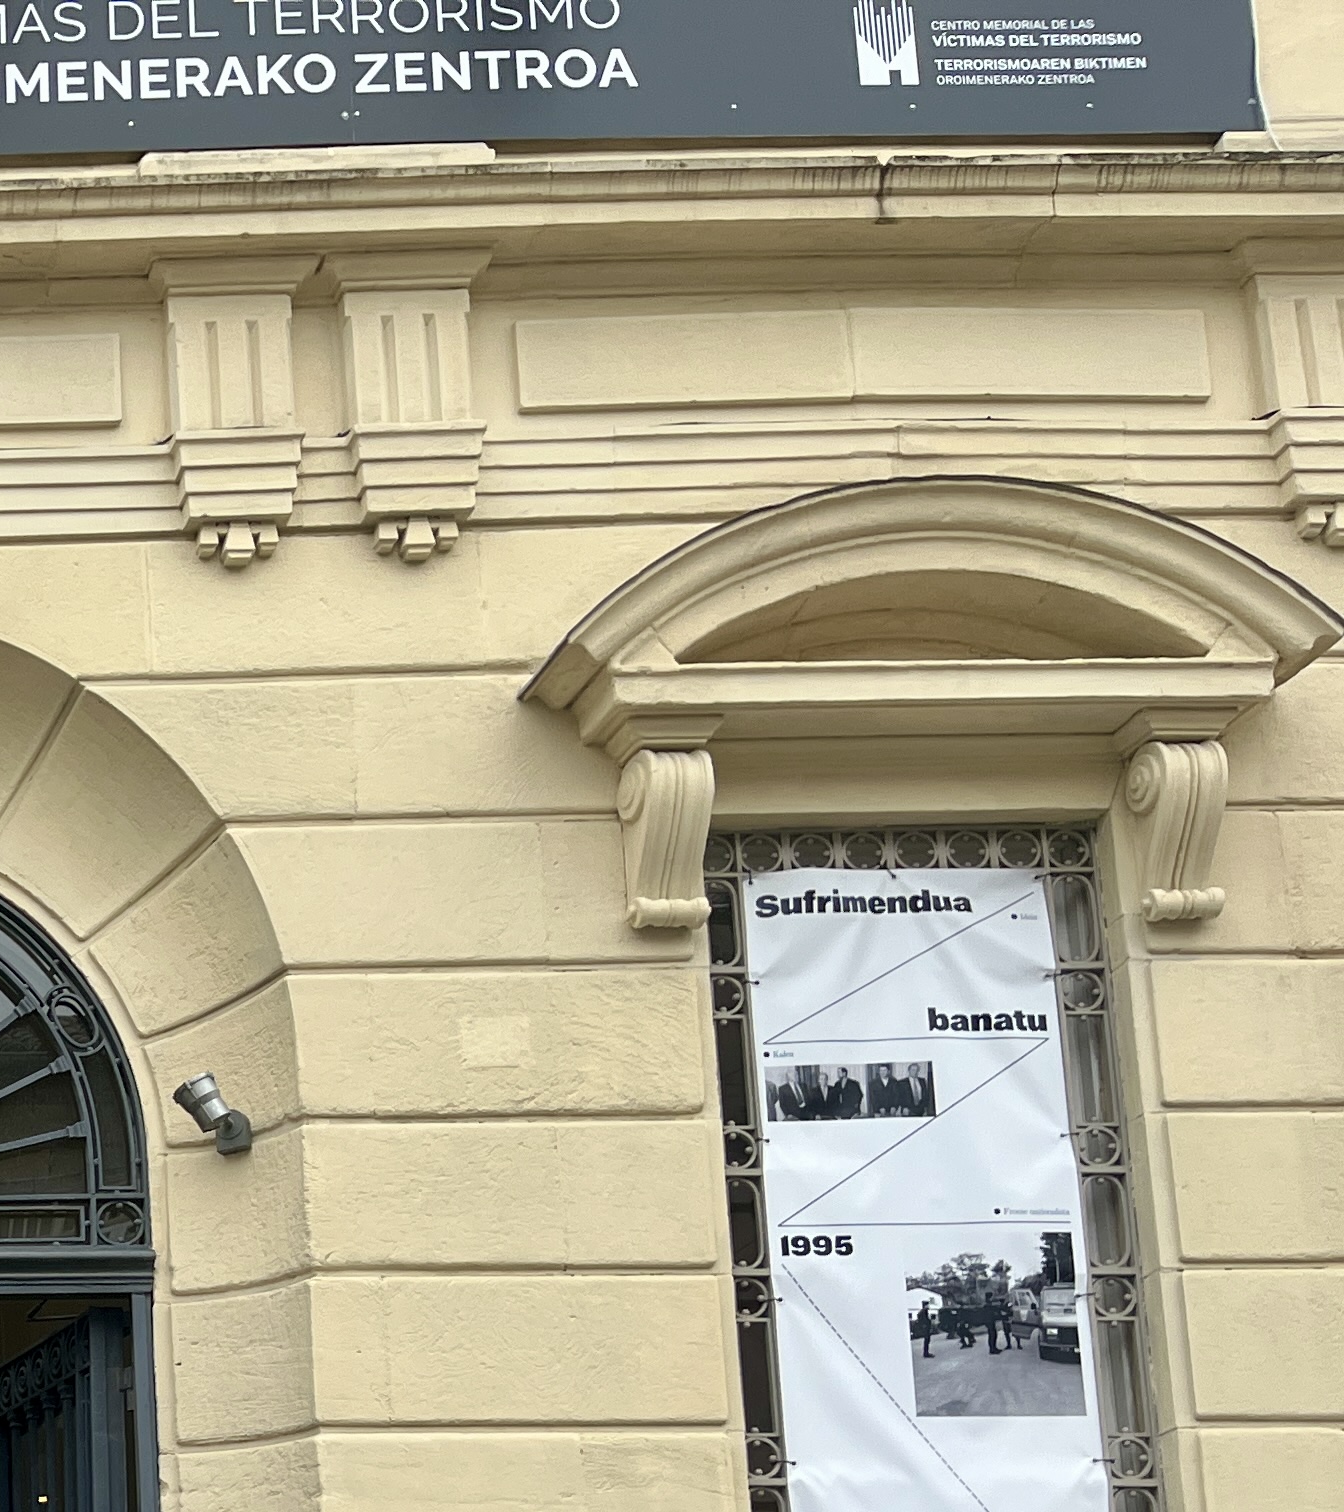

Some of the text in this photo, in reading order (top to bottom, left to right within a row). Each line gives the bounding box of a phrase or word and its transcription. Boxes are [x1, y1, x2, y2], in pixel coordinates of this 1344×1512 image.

[108, 0, 219, 40] DEL
[233, 0, 621, 36] TERRORISMO
[931, 19, 1096, 31] CENTRO MEMORIAL DE LAS
[932, 32, 1142, 48] VÍCTIMAS DEL TERRORISMO
[355, 48, 639, 94] ZENTROA
[934, 56, 1148, 71] TERRORISMOAREN BIKTIMEN
[936, 74, 1096, 86] OROIMENERAKO ZENTROA
[755, 889, 973, 918] Sufrimendua
[927, 1007, 1048, 1032] banatu
[780, 1235, 854, 1257] 1995
